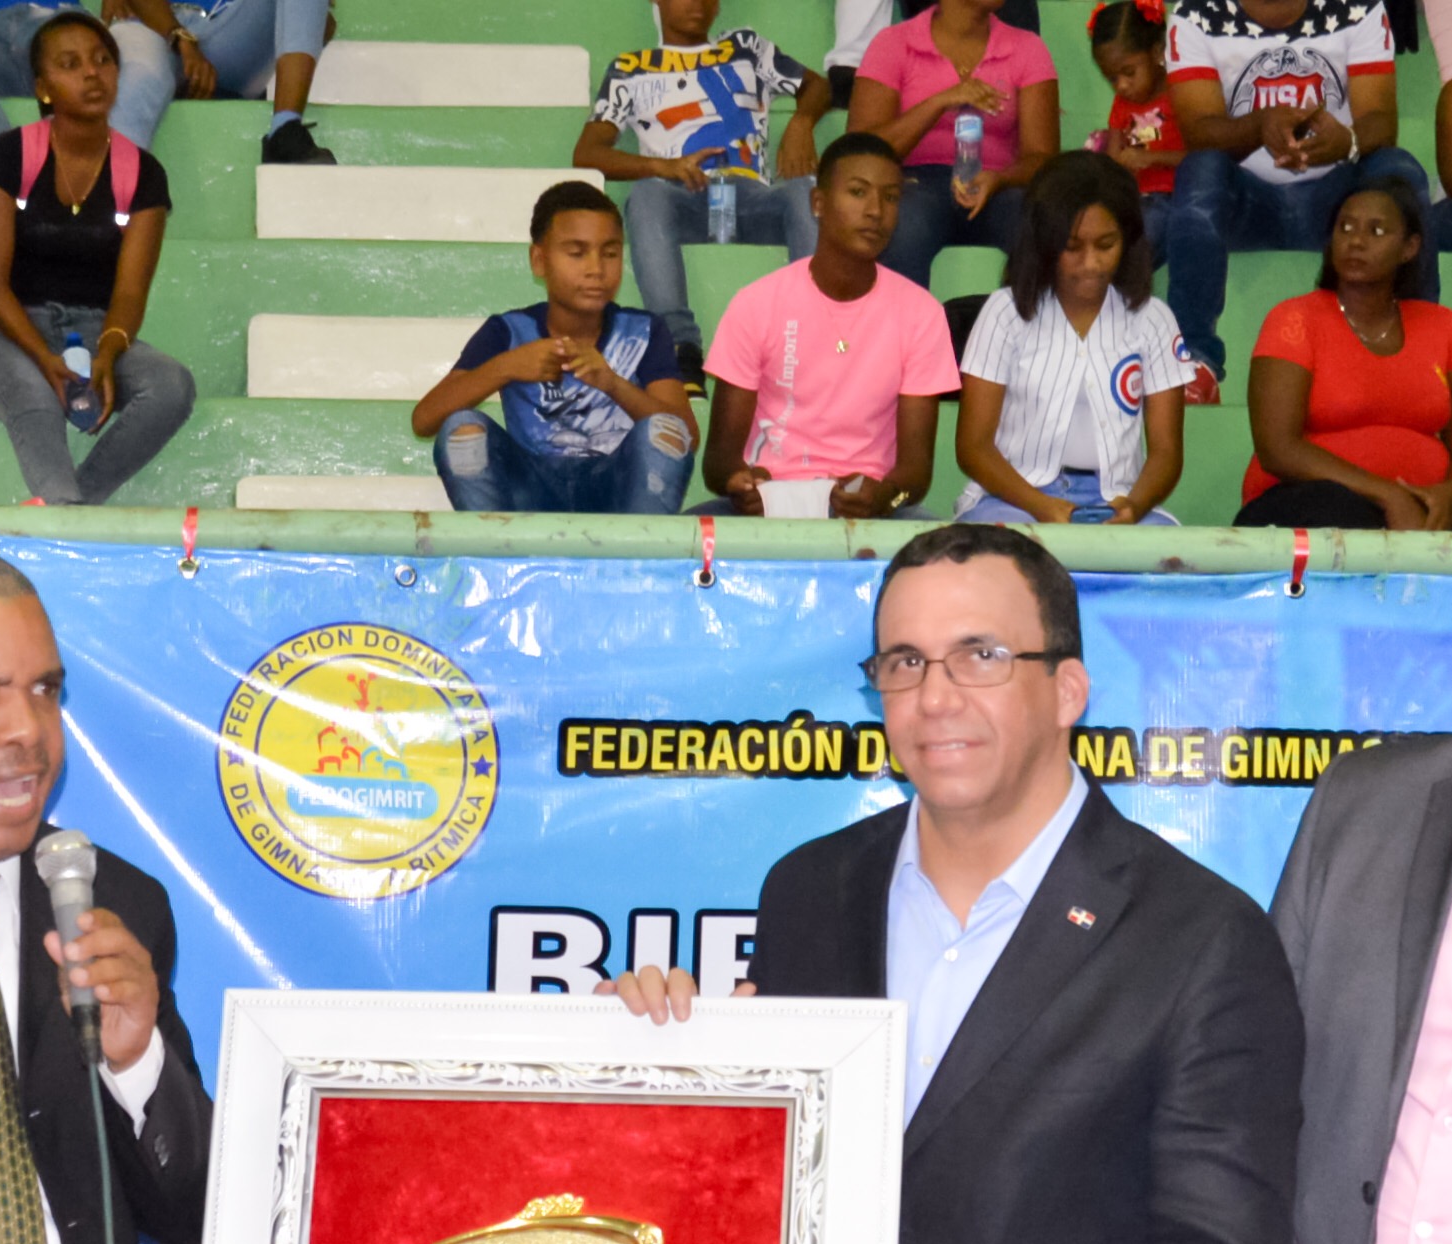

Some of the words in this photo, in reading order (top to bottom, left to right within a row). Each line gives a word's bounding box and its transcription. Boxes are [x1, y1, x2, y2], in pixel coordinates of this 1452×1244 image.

[1258, 82, 1319, 110] USA
[565, 717, 843, 773] FEDERACIÓN
[1149, 735, 1207, 779] DE
[1219, 734, 1384, 781] GIMN
[229, 782, 257, 820] DE
